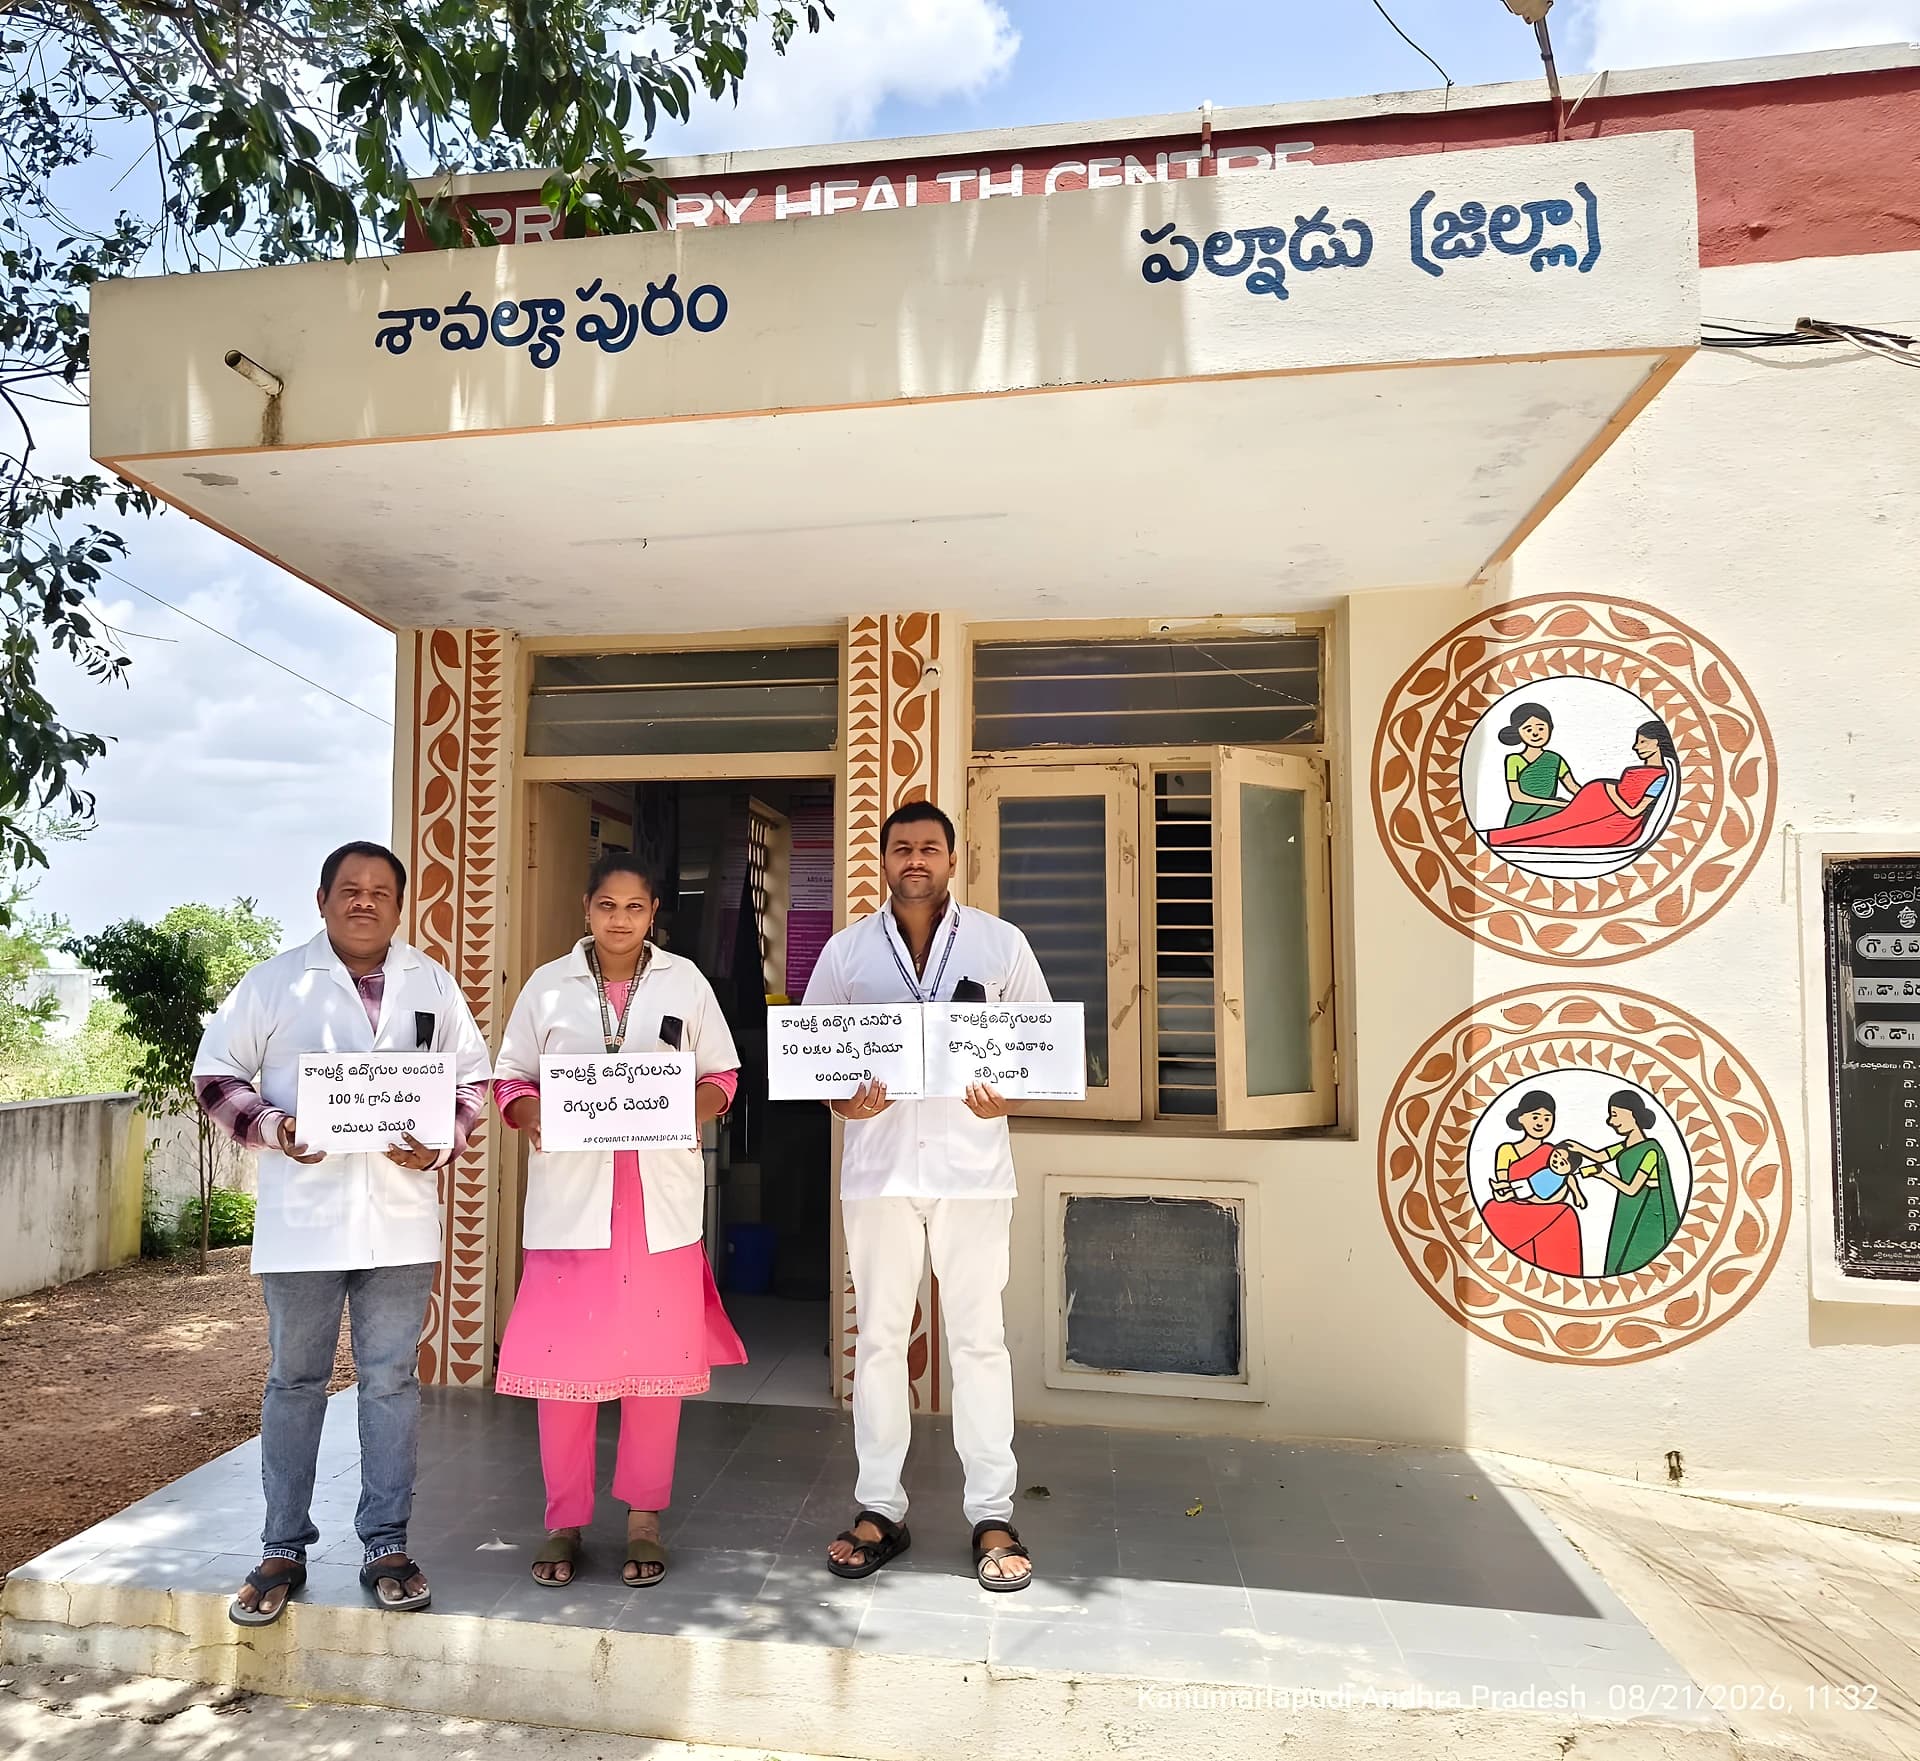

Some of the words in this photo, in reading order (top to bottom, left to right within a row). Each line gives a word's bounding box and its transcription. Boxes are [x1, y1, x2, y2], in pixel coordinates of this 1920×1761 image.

[775, 163, 1023, 220] HEALTH
[1140, 206, 1373, 300] పల్నాడు
[1410, 181, 1601, 277] (జిల్లా)
[783, 1044, 798, 1055] 50
[803, 1045, 831, 1054] లక్షల
[1005, 1042, 1053, 1051] అవకాశం
[329, 1094, 350, 1104] 100
[369, 1092, 390, 1106] గ్రాస్
[564, 1097, 617, 1119] రెగ్యులర్
[332, 1123, 373, 1133] అమలు
